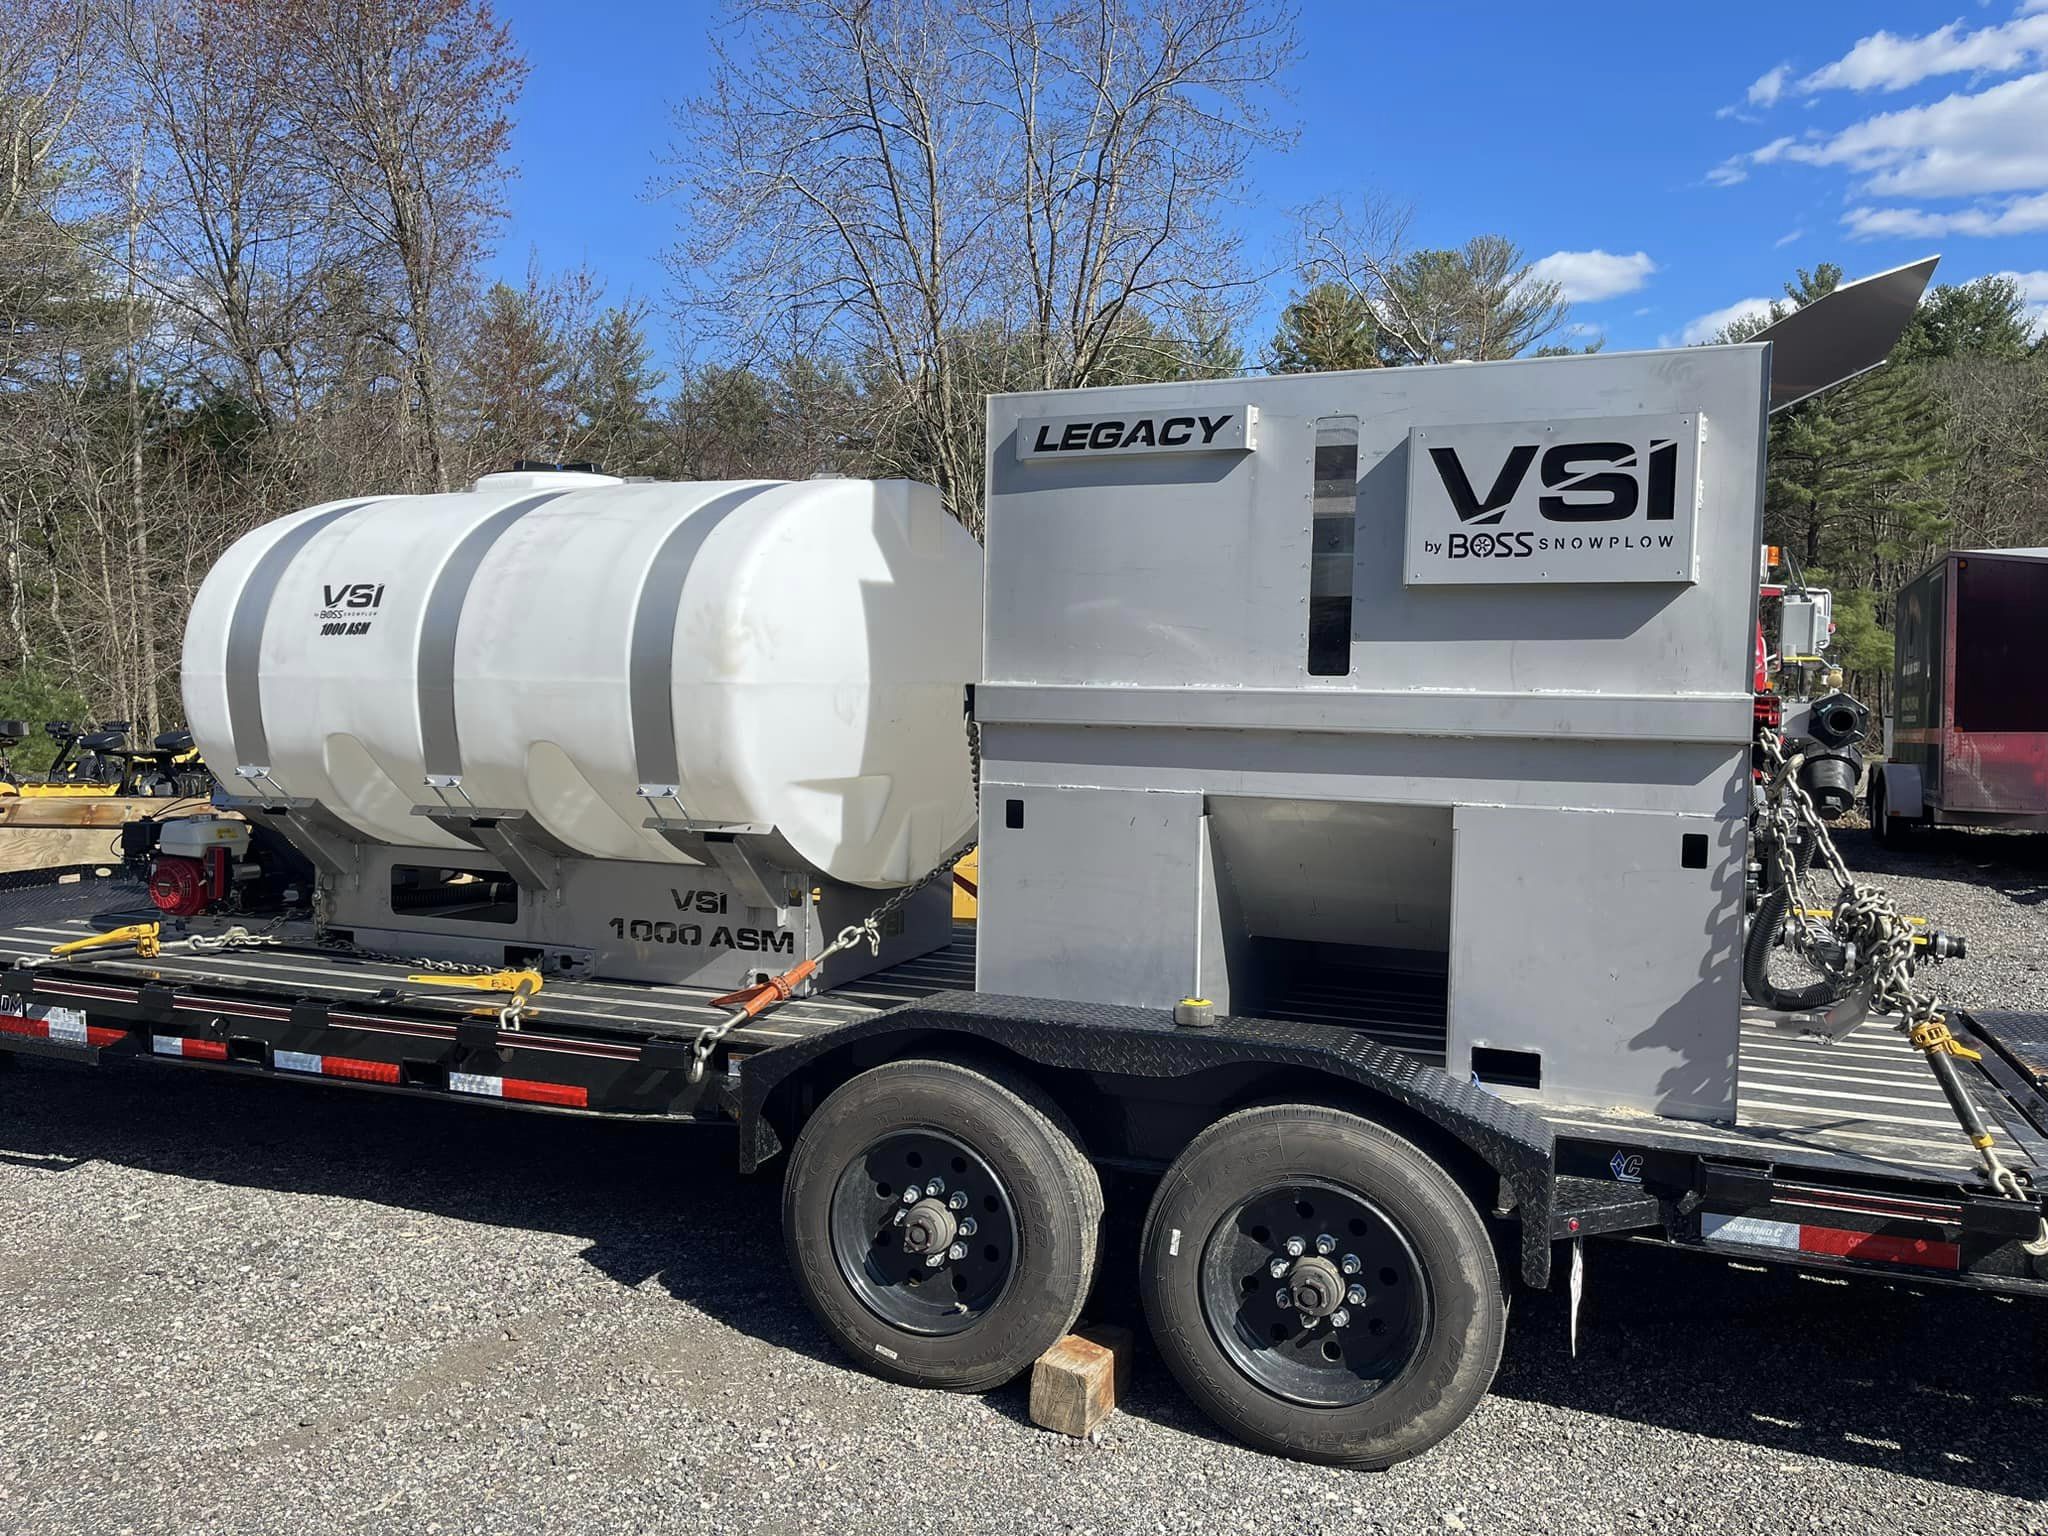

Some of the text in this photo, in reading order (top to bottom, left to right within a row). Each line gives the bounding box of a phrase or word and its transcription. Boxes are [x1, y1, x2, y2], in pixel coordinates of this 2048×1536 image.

[1034, 415, 1234, 452] LEGACY
[1425, 532, 1674, 559] by BOSS SNOWPLOW
[320, 610, 343, 619] BOSS
[320, 622, 371, 636] 1000 ASM
[609, 917, 794, 954] 1000 ASM
